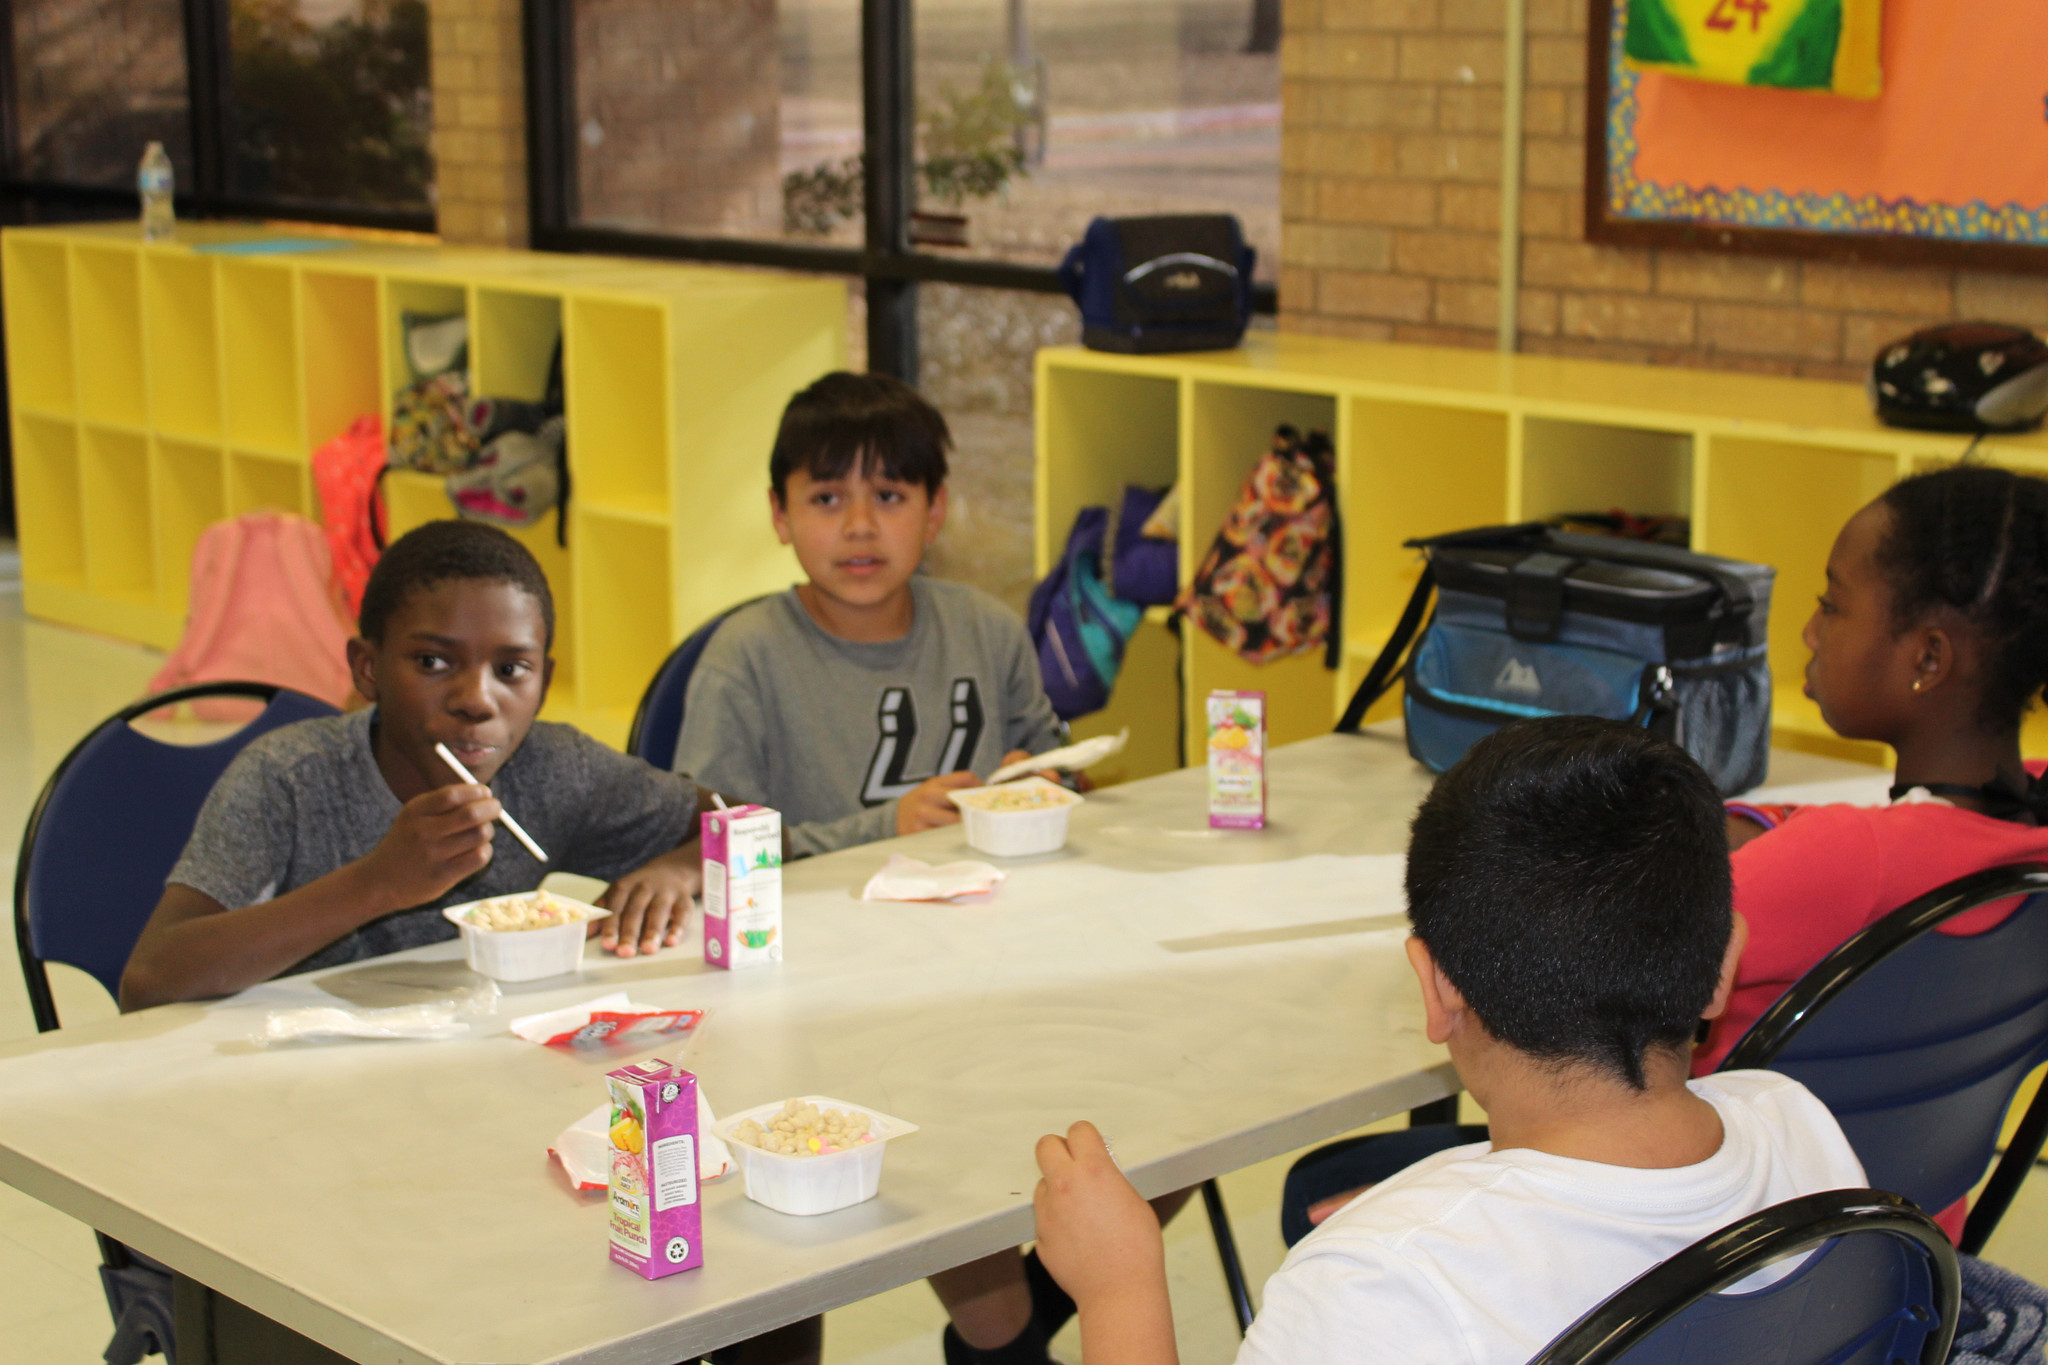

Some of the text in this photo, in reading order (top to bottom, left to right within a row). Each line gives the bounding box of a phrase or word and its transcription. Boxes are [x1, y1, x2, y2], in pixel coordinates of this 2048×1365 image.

[613, 1190, 640, 1212] Ardmore
[609, 1219, 624, 1235] Fruit
[623, 1227, 647, 1245] Punch
[613, 1212, 641, 1232] Tropical
